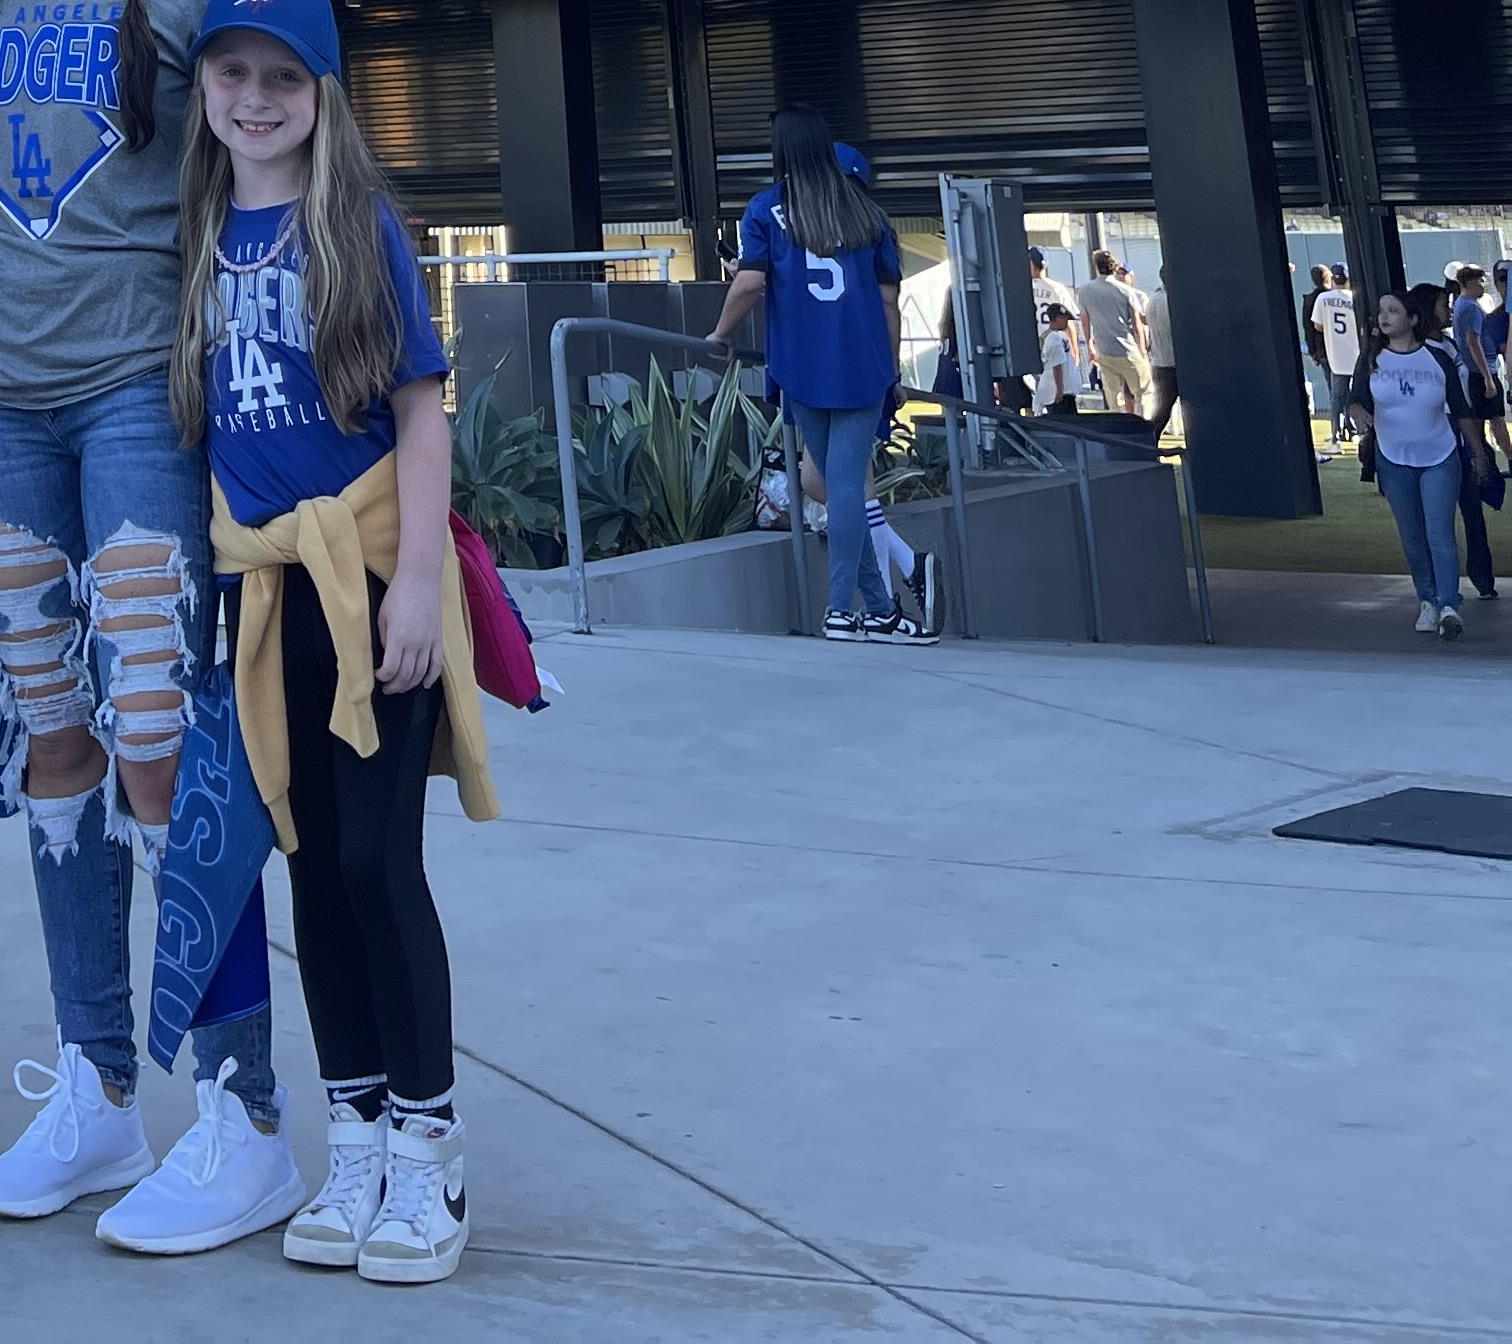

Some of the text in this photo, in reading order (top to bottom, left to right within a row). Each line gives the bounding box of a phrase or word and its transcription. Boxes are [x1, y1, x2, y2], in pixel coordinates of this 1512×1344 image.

[14, 2, 123, 24] ANGELE
[7, 113, 54, 198] LA
[805, 241, 846, 302] 5
[1323, 297, 1353, 310] FREEMA
[1333, 311, 1347, 335] 5
[225, 318, 289, 413] LA
